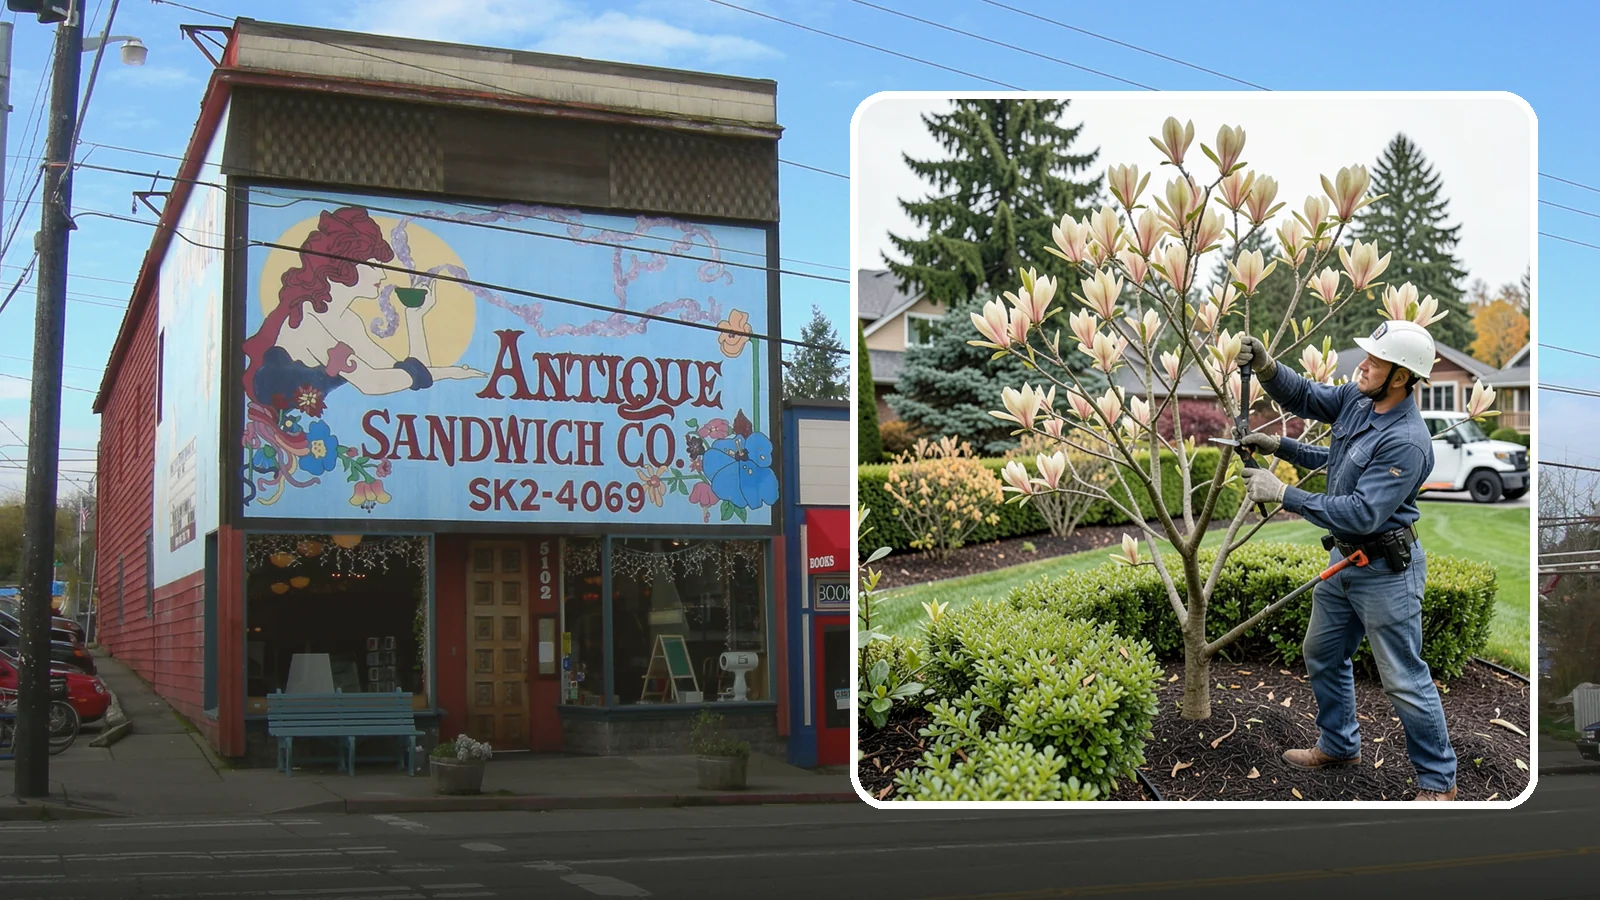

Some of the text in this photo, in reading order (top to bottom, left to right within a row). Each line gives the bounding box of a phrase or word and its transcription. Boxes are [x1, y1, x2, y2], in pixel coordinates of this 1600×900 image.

[476, 329, 724, 420] ANTIQUE
[361, 409, 684, 468] SANDWICH CO.
[469, 477, 645, 513] SK2-4069
[539, 540, 552, 599] 5102
[809, 555, 835, 569] BOOKS
